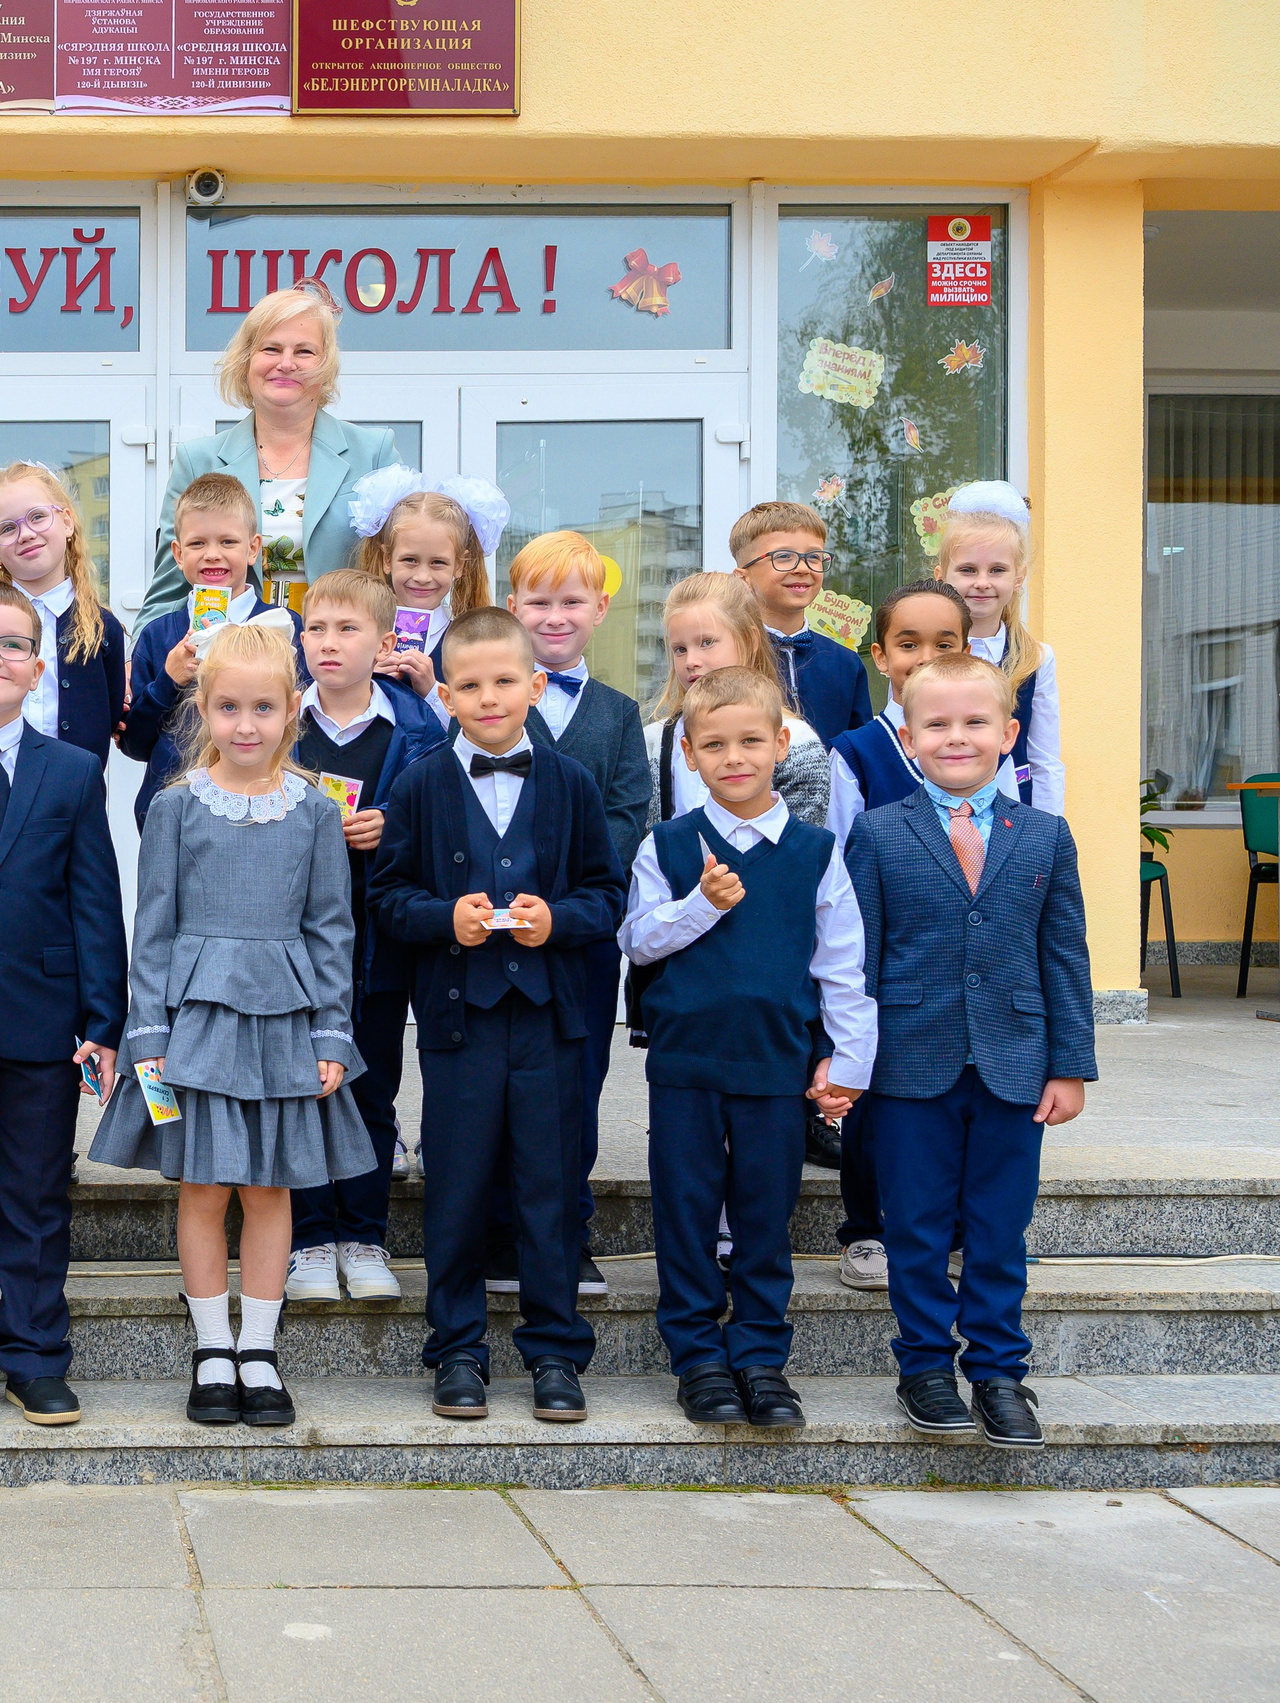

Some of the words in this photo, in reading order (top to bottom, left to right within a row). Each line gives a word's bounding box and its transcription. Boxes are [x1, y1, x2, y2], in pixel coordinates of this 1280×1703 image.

[85, 8, 143, 17] ДЗЯРЖАЎНАЯ
[193, 11, 275, 19] ГОСУДАРСТВЕННОЕ
[205, 19, 263, 27] УЧРЕЖДЕНИЕ
[332, 19, 482, 33] ШЕФСТВУЮЩАЯ
[0, 33, 51, 43] Минска
[57, 43, 124, 53] «СЯРЭДНЯЯ
[126, 43, 170, 52] ШКОЛА
[177, 43, 241, 52] «СРЕДНЯЯ
[242, 43, 287, 52] ШКОЛА
[341, 37, 472, 51] ОРГАНИЗАЦИЯ
[114, 56, 161, 65] МІНСКА
[229, 56, 281, 65] МИНСКА
[311, 62, 364, 70] ОТКРЫТОЕ
[370, 62, 442, 71] АКЦИОНЕРНОЕ
[447, 62, 502, 71] ОБЩЕСТВО
[82, 68, 101, 76] ІМЯ
[103, 67, 142, 76] ГЕРОЯЎ
[193, 68, 229, 76] ИМЕНИ
[231, 68, 270, 76] ГЕРОЕВ
[76, 80, 101, 88] 120-Й
[191, 80, 216, 88] 120-Й
[218, 81, 271, 89] ДИВИЗИИ»
[303, 78, 509, 93] «БЕЛЭНЕРГОРЕМНАЛАДКА»
[931, 263, 987, 280] ЗДЕСЬ
[930, 293, 988, 303] МИЛИЦИЮ
[819, 342, 867, 367] Вперёд
[817, 359, 872, 380] знаниям!
[824, 592, 850, 611] Буду
[808, 602, 864, 627] тличником!
